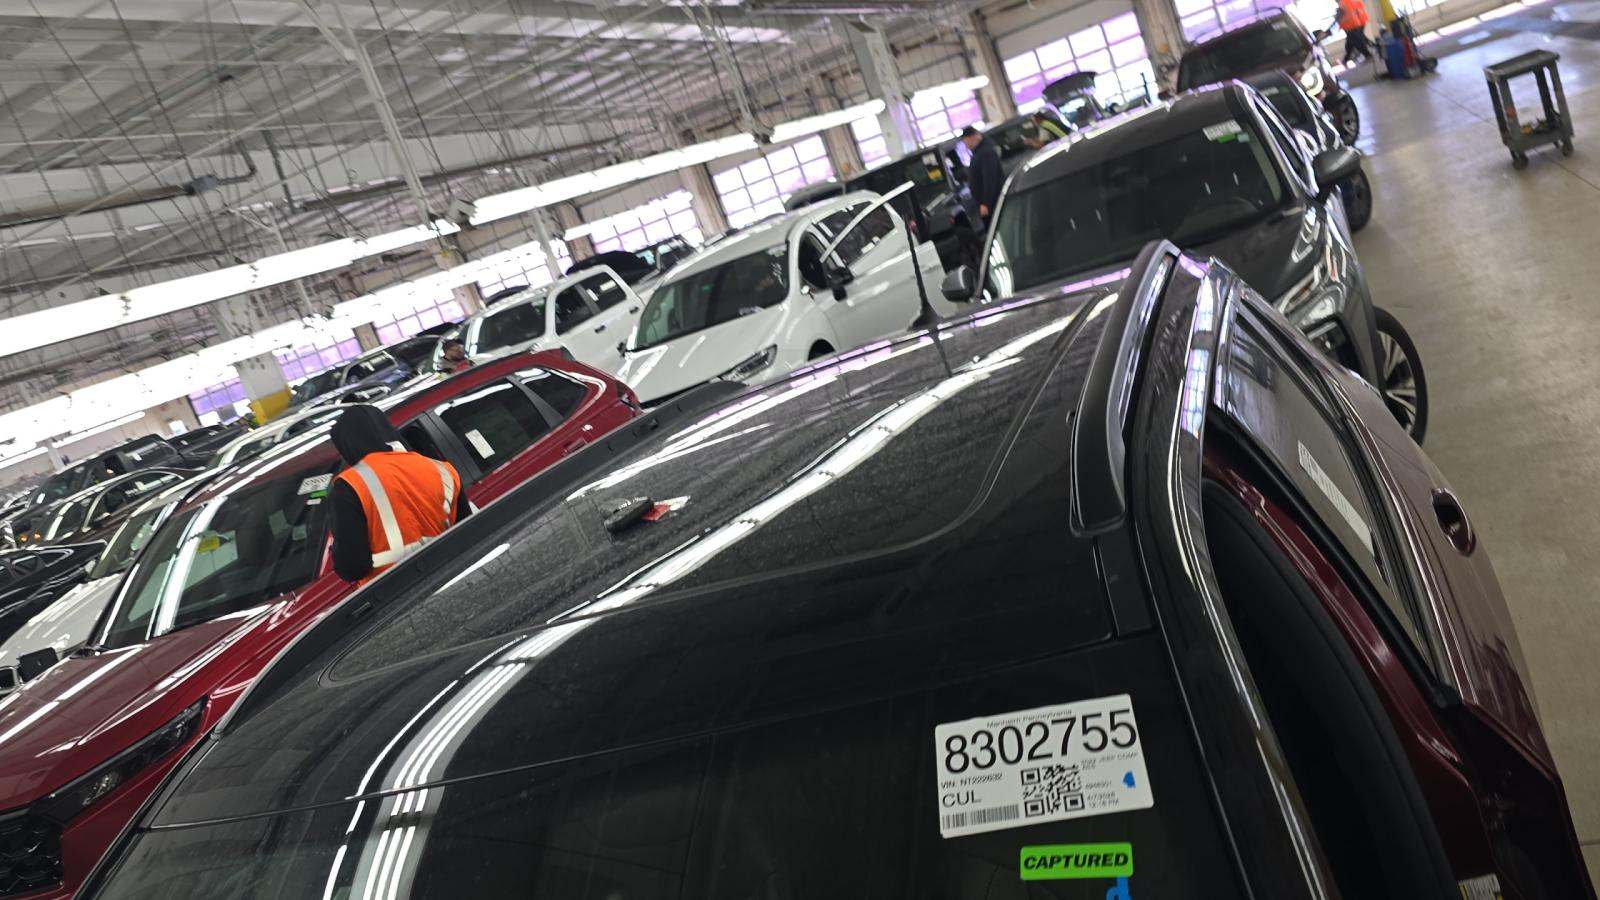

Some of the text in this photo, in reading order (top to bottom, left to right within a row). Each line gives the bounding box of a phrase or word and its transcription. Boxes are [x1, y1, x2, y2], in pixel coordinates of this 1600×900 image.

[945, 708, 1137, 774] 8302755
[942, 790, 982, 808] CUL
[1024, 852, 1129, 870] CAPTURED
